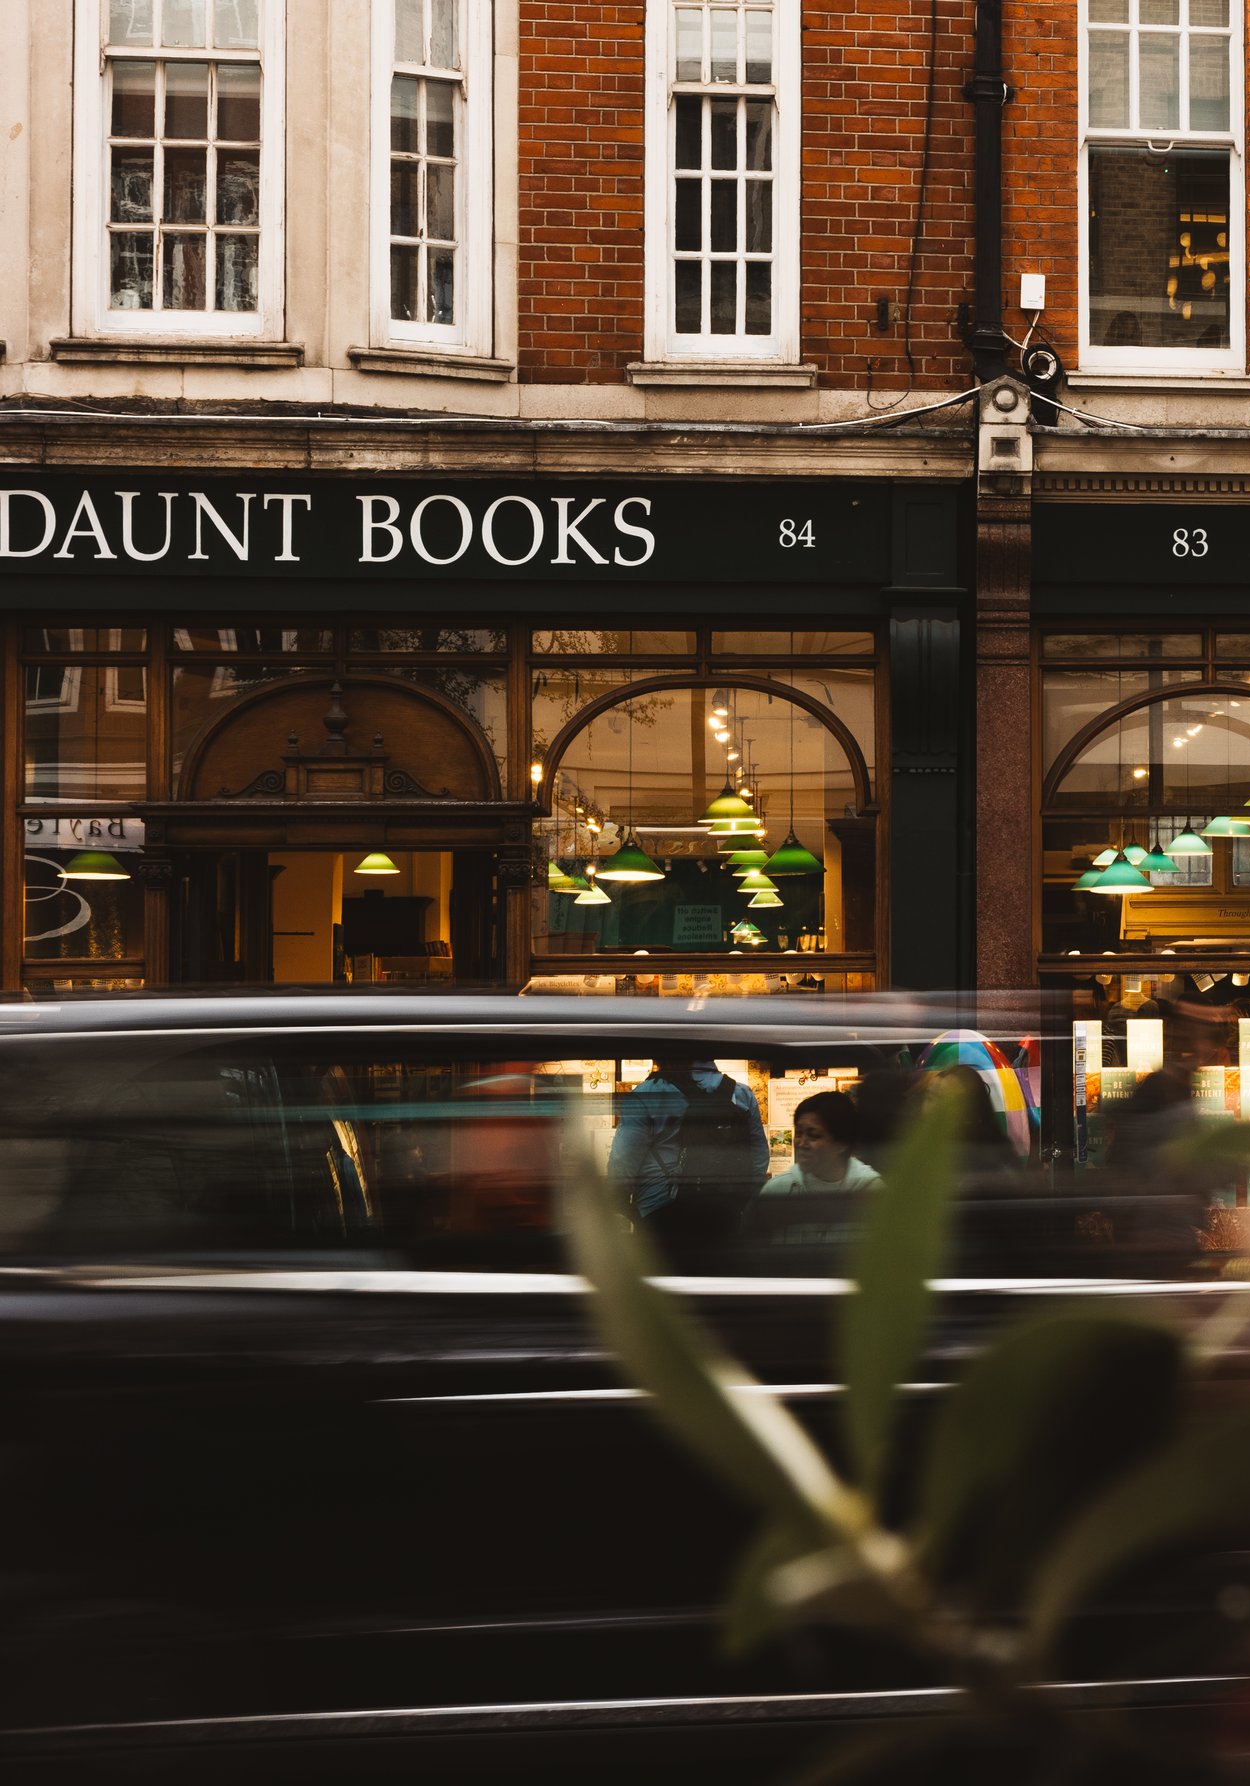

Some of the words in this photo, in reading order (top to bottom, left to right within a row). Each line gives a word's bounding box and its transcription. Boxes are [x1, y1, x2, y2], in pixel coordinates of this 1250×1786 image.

[0, 489, 312, 562] DAUNT
[356, 494, 656, 566] BOOKS
[778, 518, 816, 548] 84
[1172, 528, 1209, 557] 83
[1113, 1081, 1123, 1089] BE
[1201, 1079, 1211, 1088] BE
[1102, 1090, 1135, 1099] PATIENT
[1190, 1089, 1223, 1098] PATIENT
